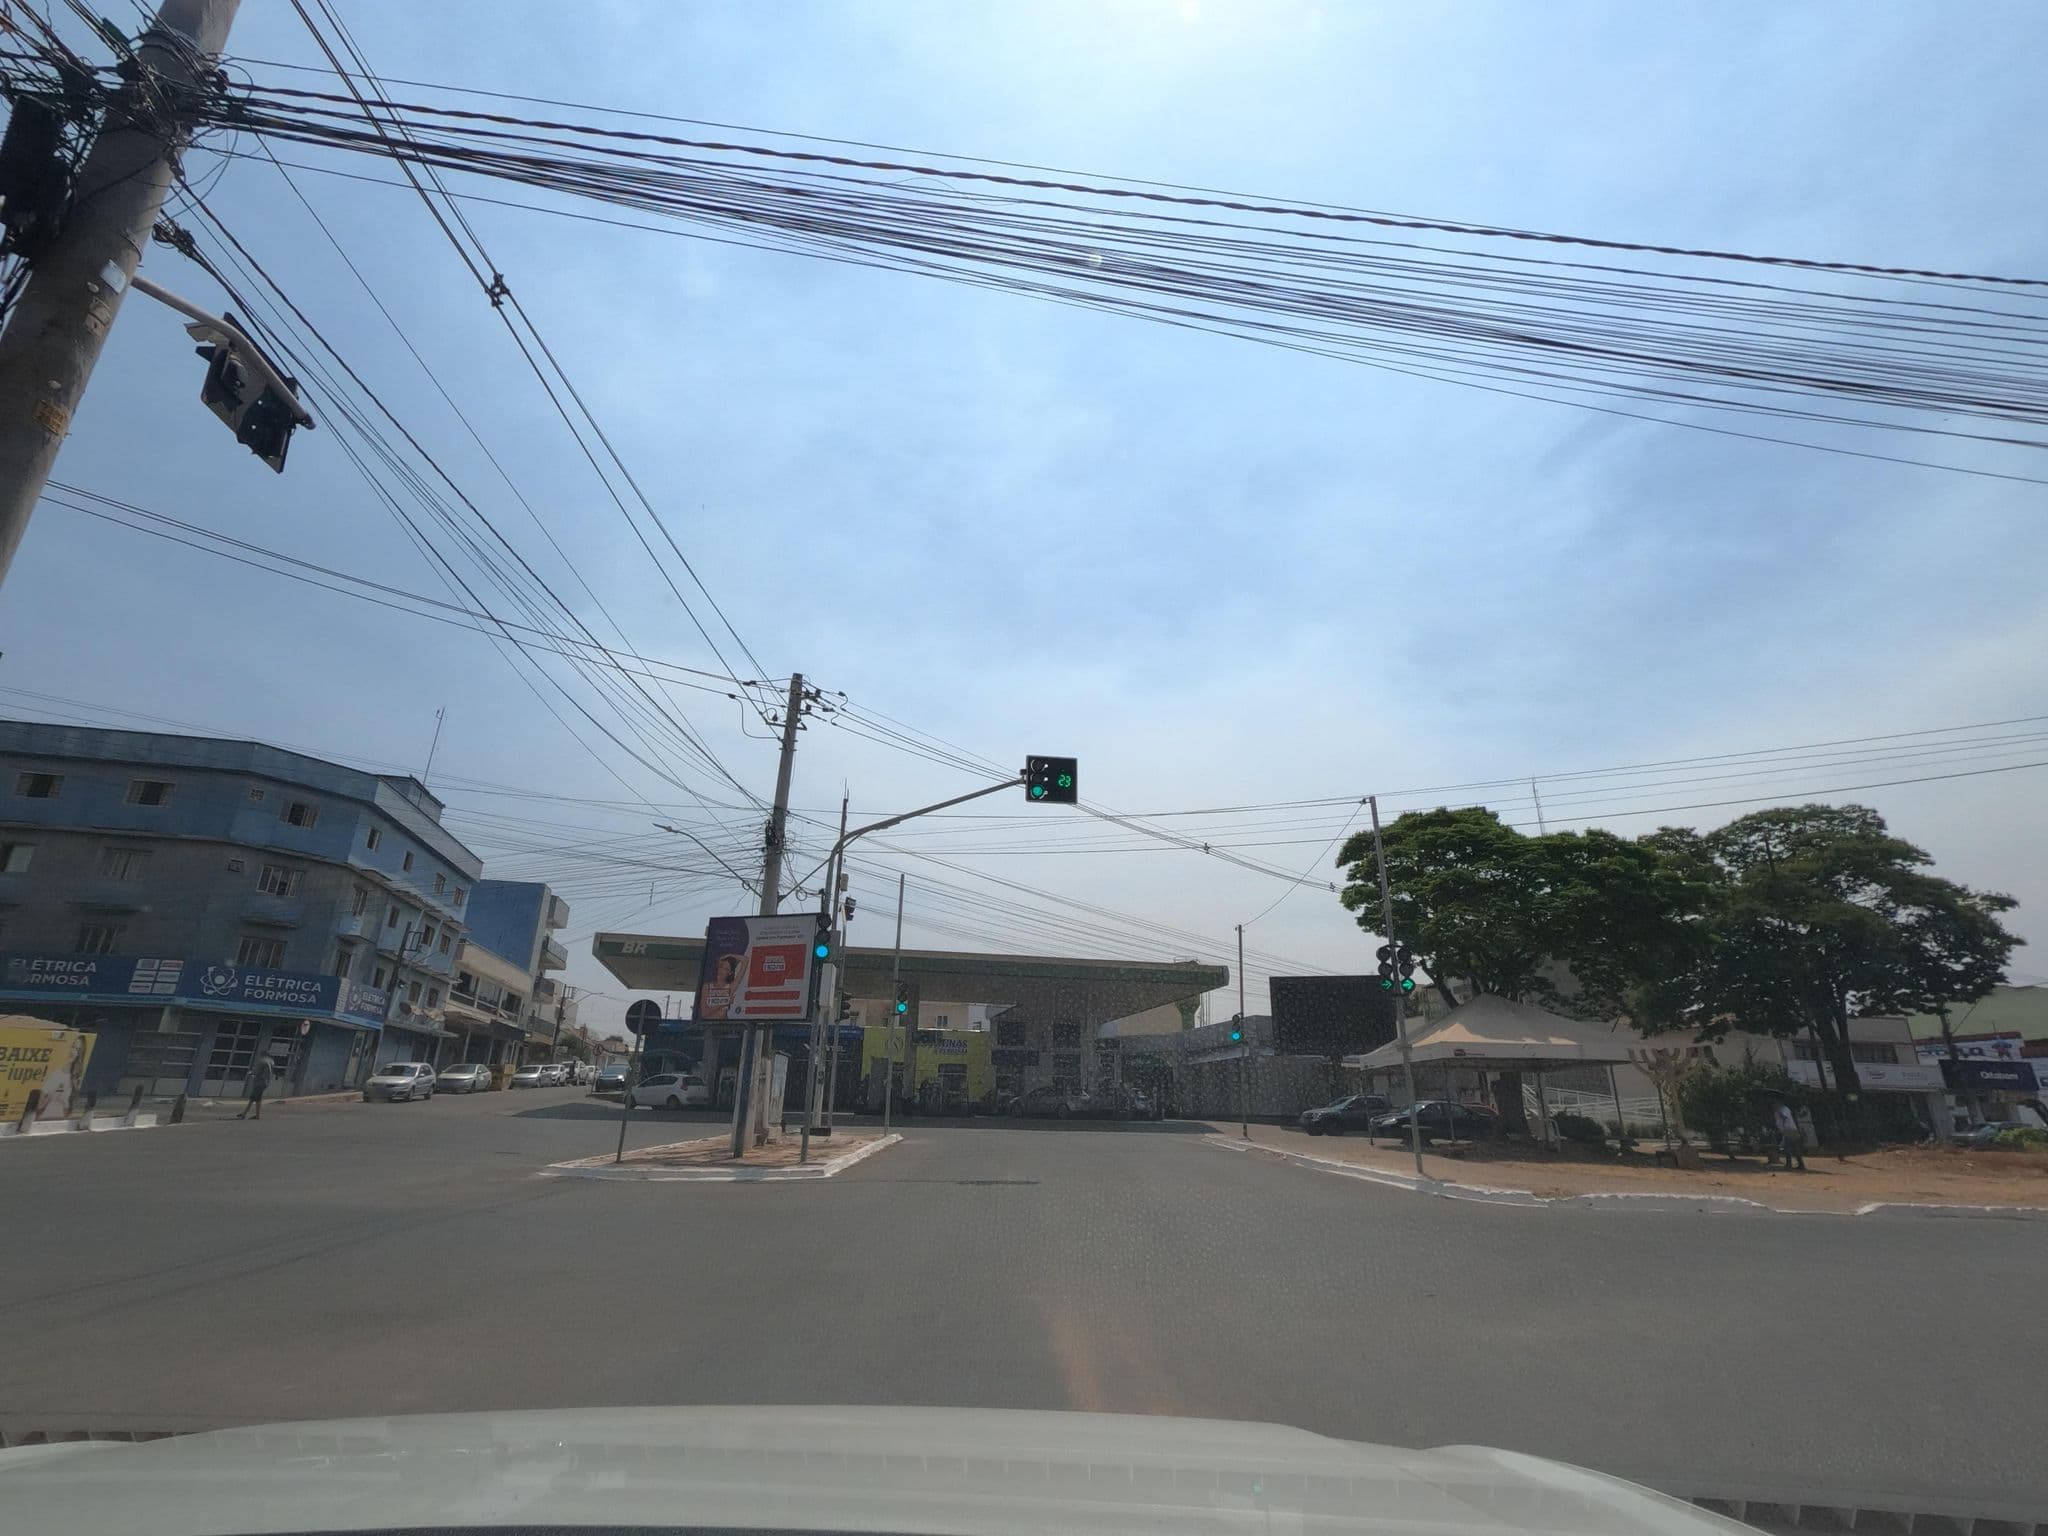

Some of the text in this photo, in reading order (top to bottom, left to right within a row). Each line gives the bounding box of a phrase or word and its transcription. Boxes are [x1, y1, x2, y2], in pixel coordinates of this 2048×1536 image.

[622, 942, 648, 955] BR
[26, 973, 89, 986] RMOSA
[245, 975, 322, 993] ELÉTRICA
[243, 988, 317, 1004] FORMOSA
